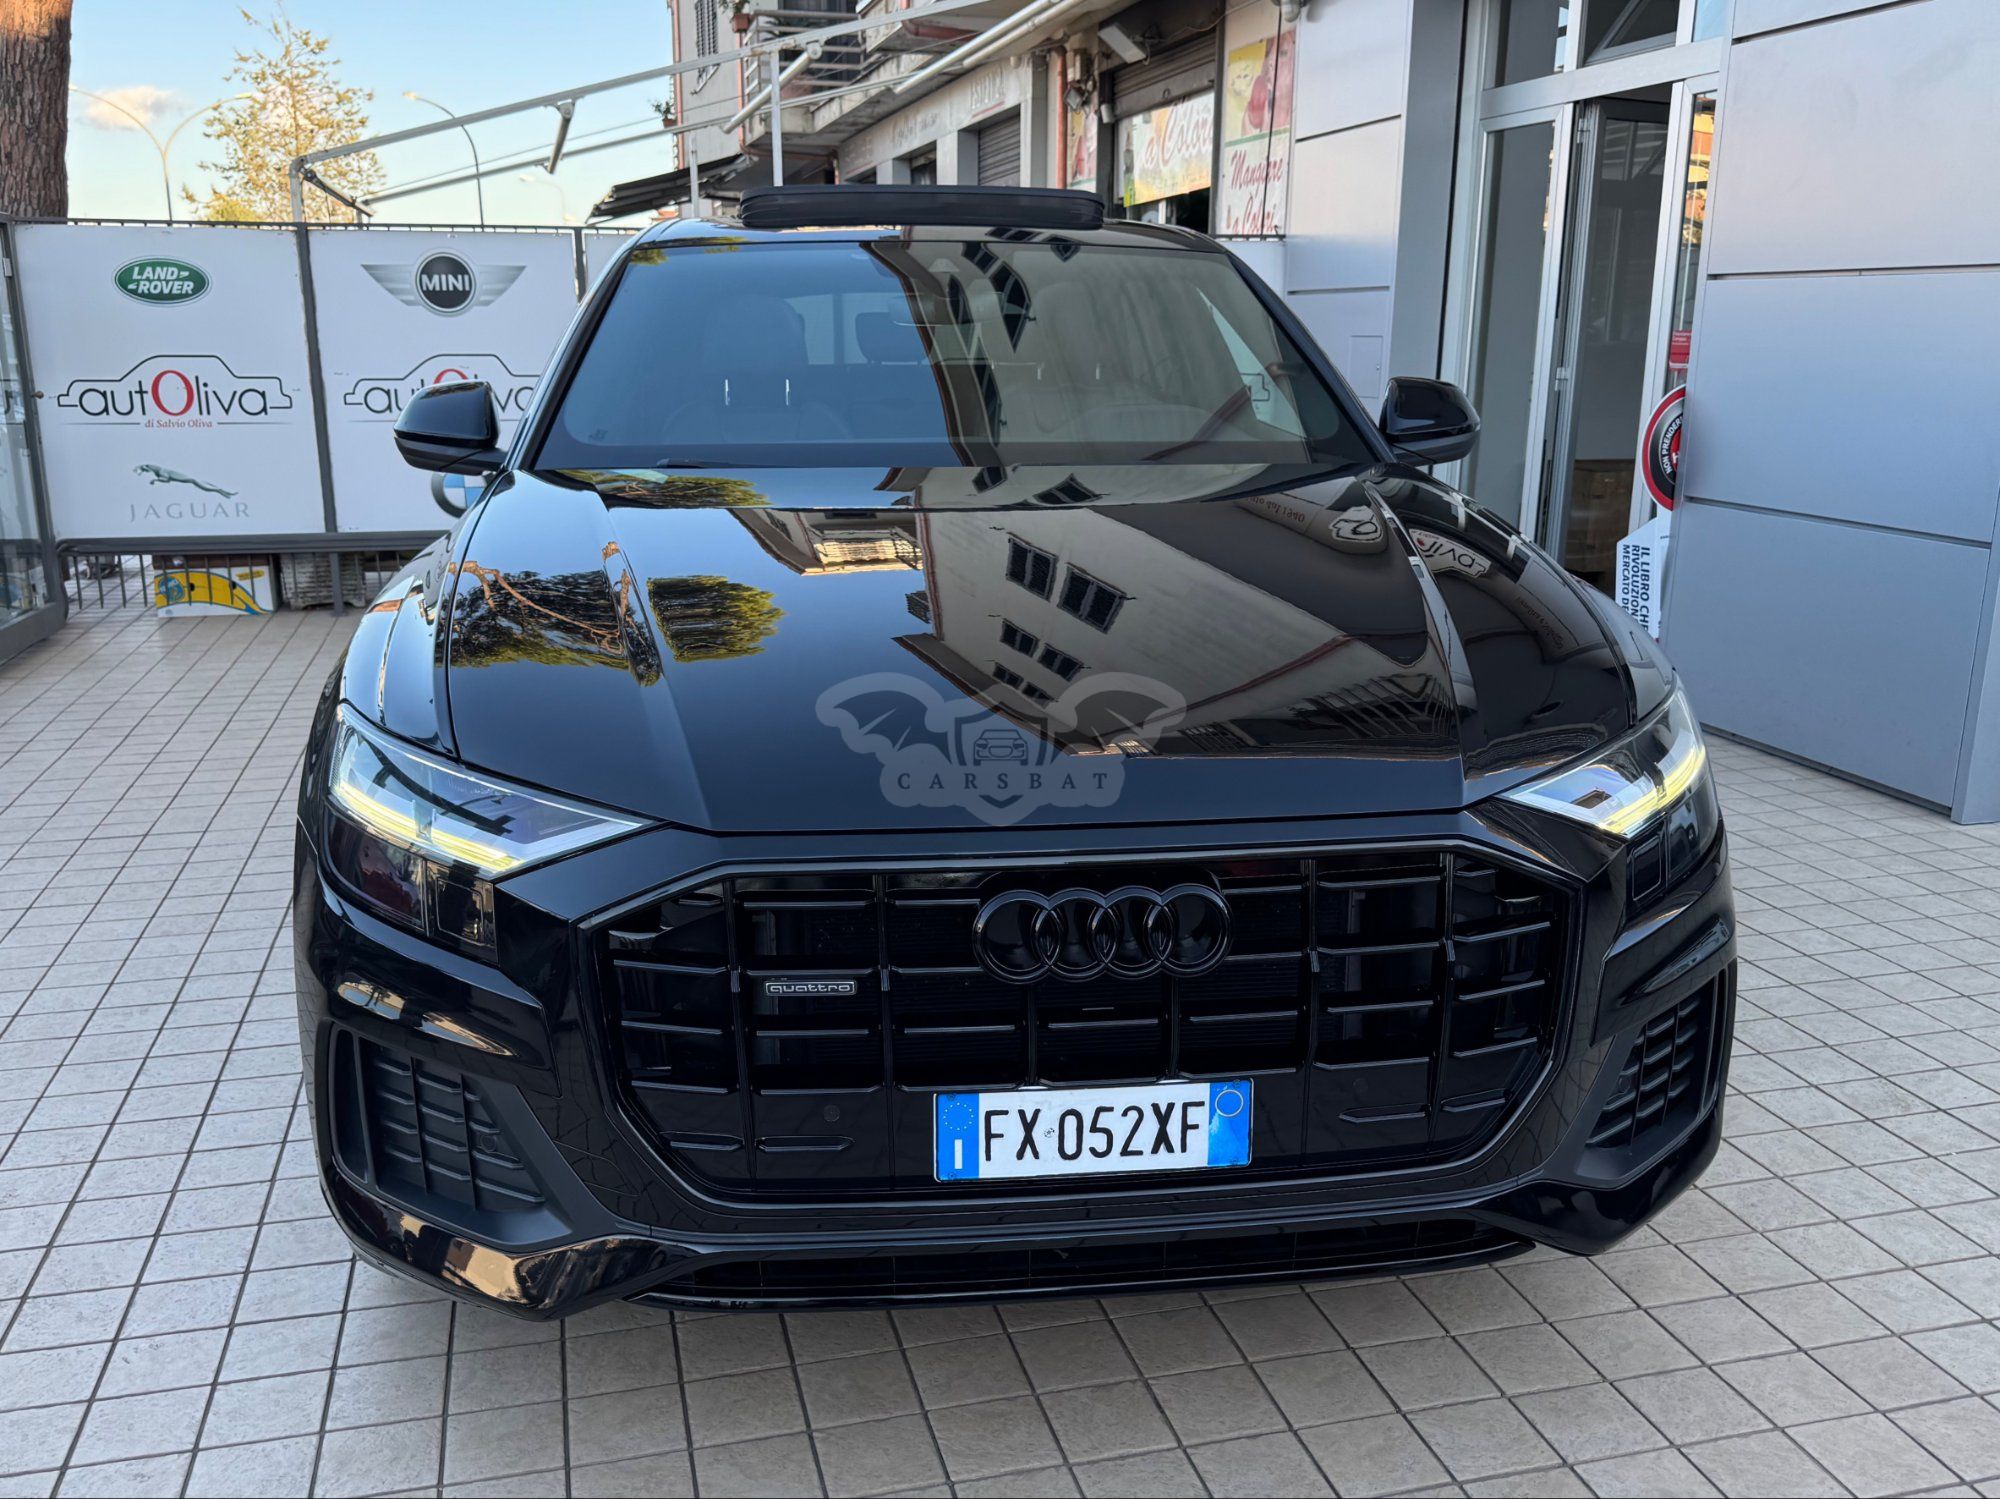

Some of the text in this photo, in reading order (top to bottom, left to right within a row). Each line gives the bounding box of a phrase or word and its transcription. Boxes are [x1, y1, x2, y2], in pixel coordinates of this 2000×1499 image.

[132, 266, 179, 280] LAND
[137, 280, 195, 294] ROVER
[420, 274, 471, 292] MINI
[78, 369, 269, 417] autOliva
[144, 418, 213, 429] di Salvio Oliva
[1661, 415, 1683, 455] PRENDER
[1661, 456, 1673, 475] NON
[130, 501, 251, 523] JAGUAR
[1640, 546, 1651, 558] IL
[1621, 544, 1631, 596] MERCATO
[1640, 562, 1651, 602] LIBRO
[770, 984, 851, 994] quattro
